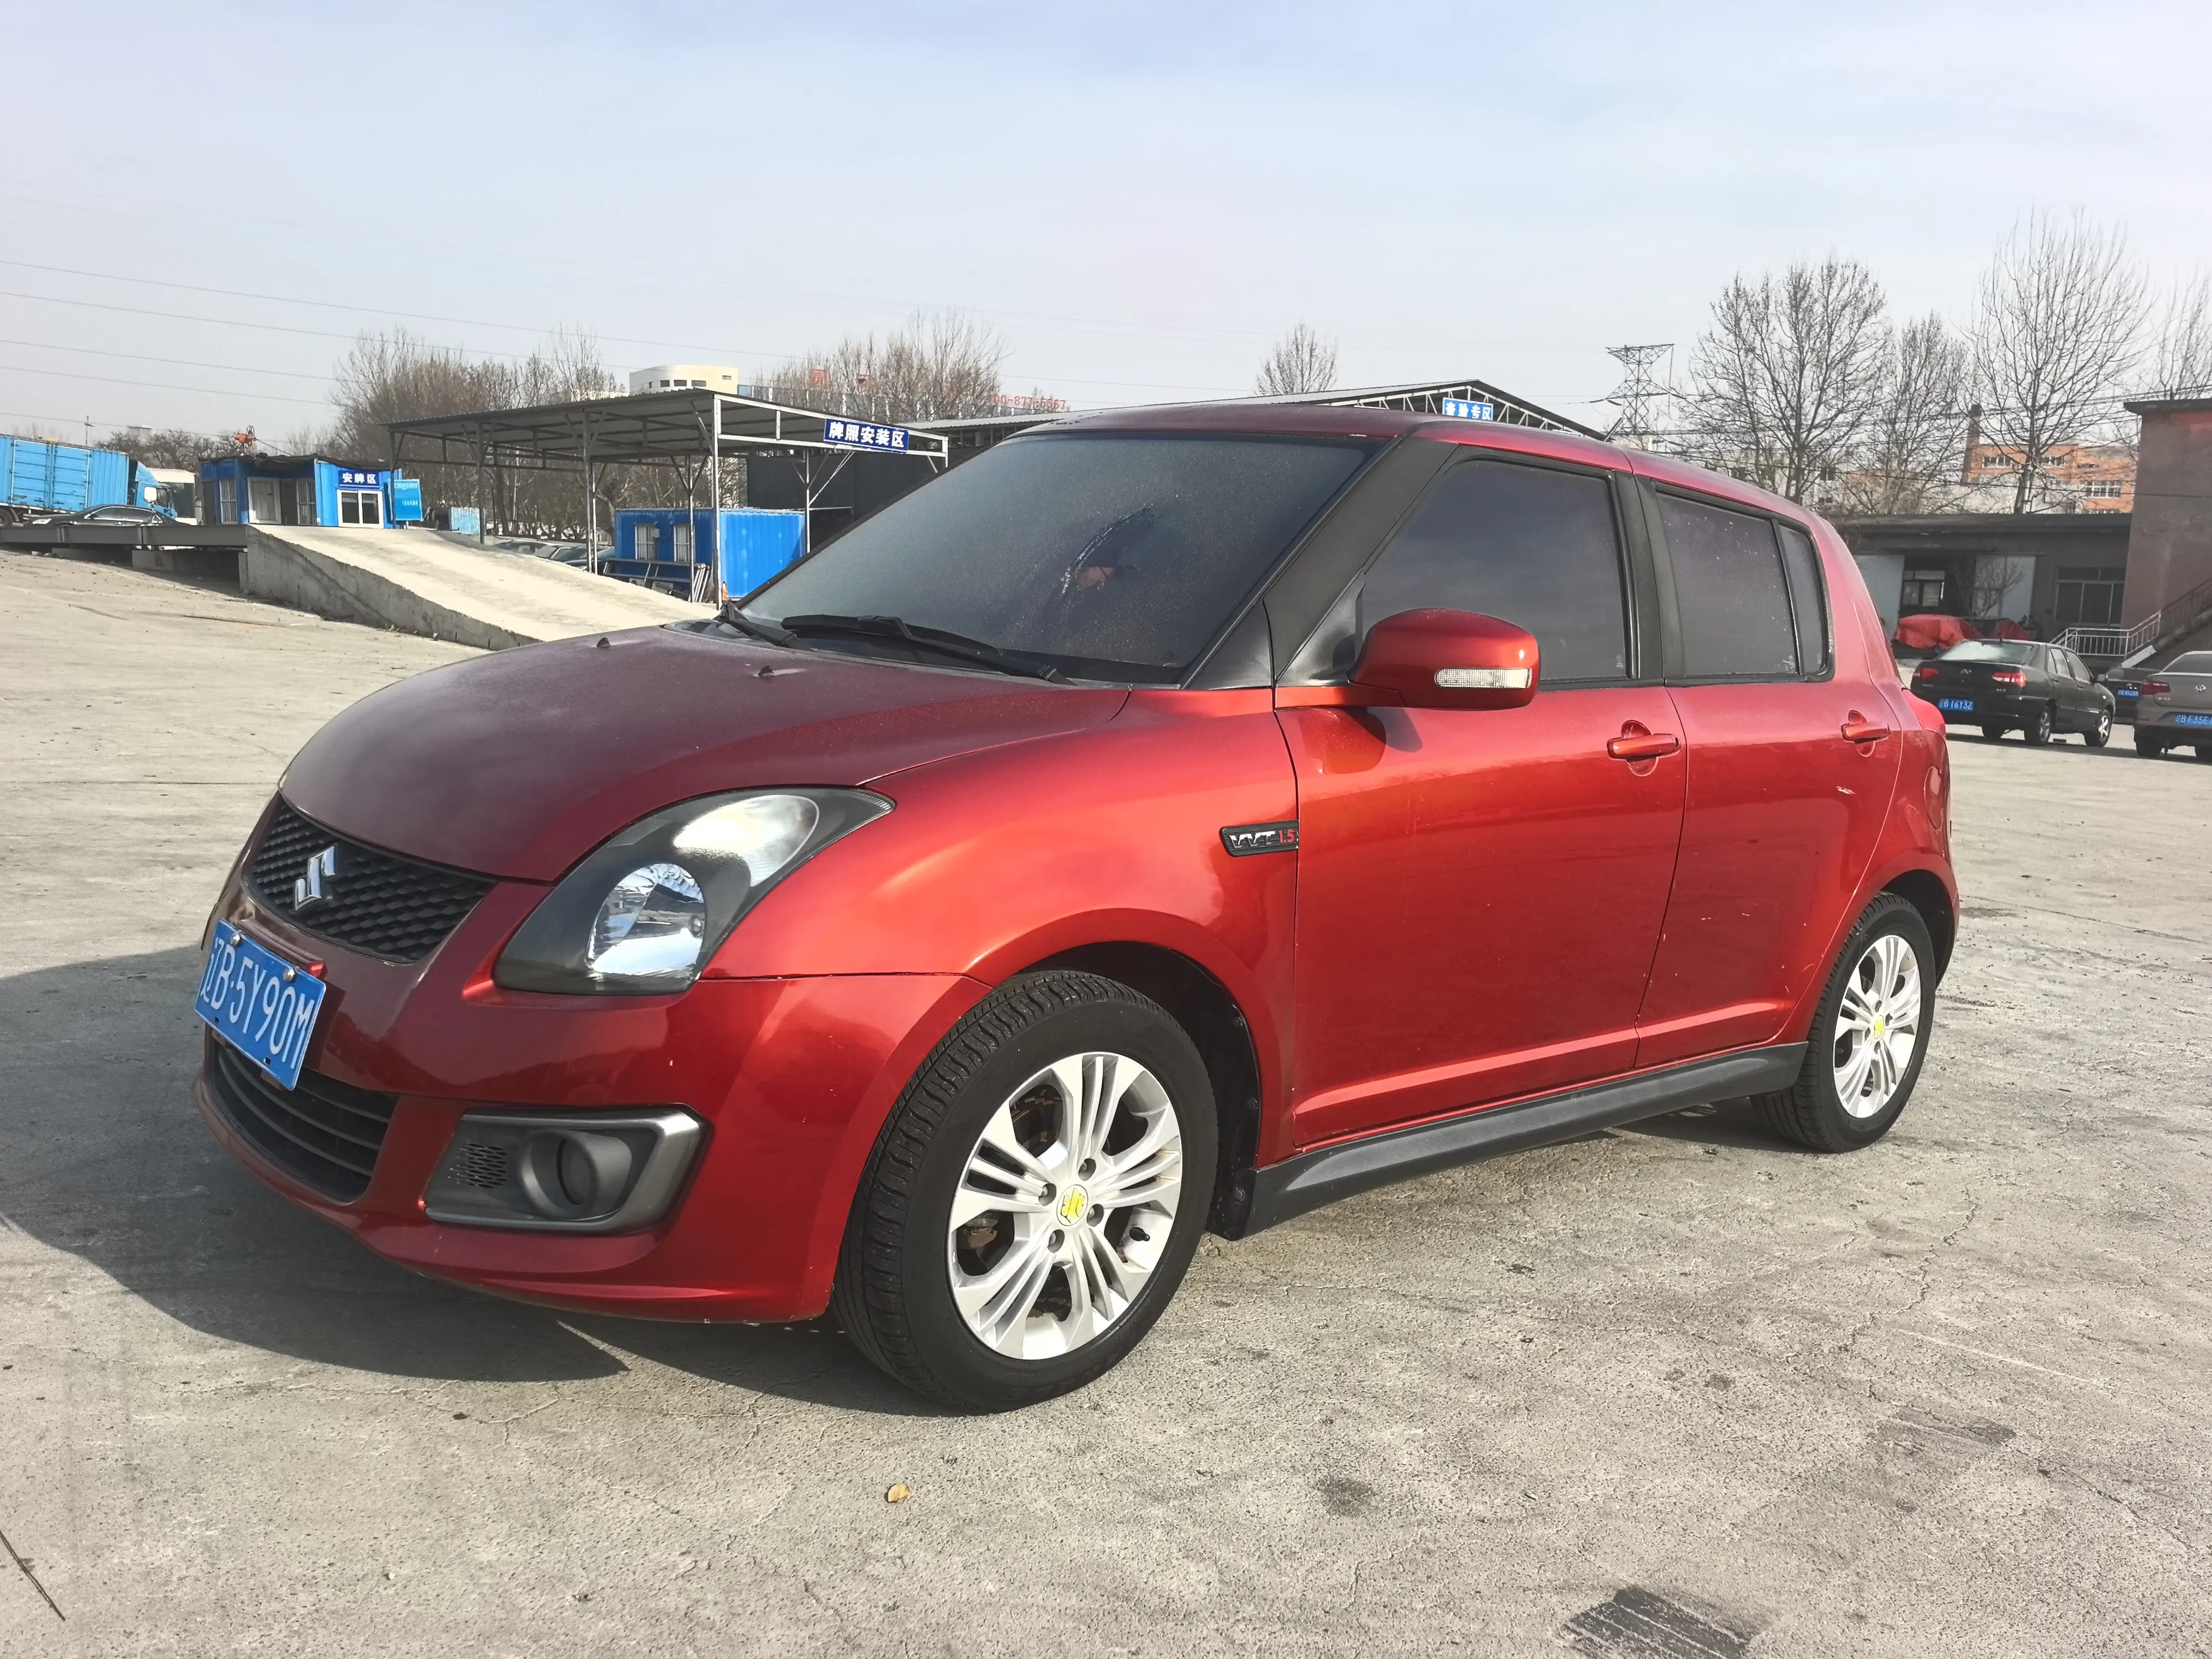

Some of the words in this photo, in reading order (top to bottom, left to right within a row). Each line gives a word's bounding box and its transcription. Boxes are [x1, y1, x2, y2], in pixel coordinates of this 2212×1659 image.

[828, 421, 905, 448] 牌照安装区
[342, 472, 376, 484] 安牌区
[1279, 829, 1295, 844] 1.5
